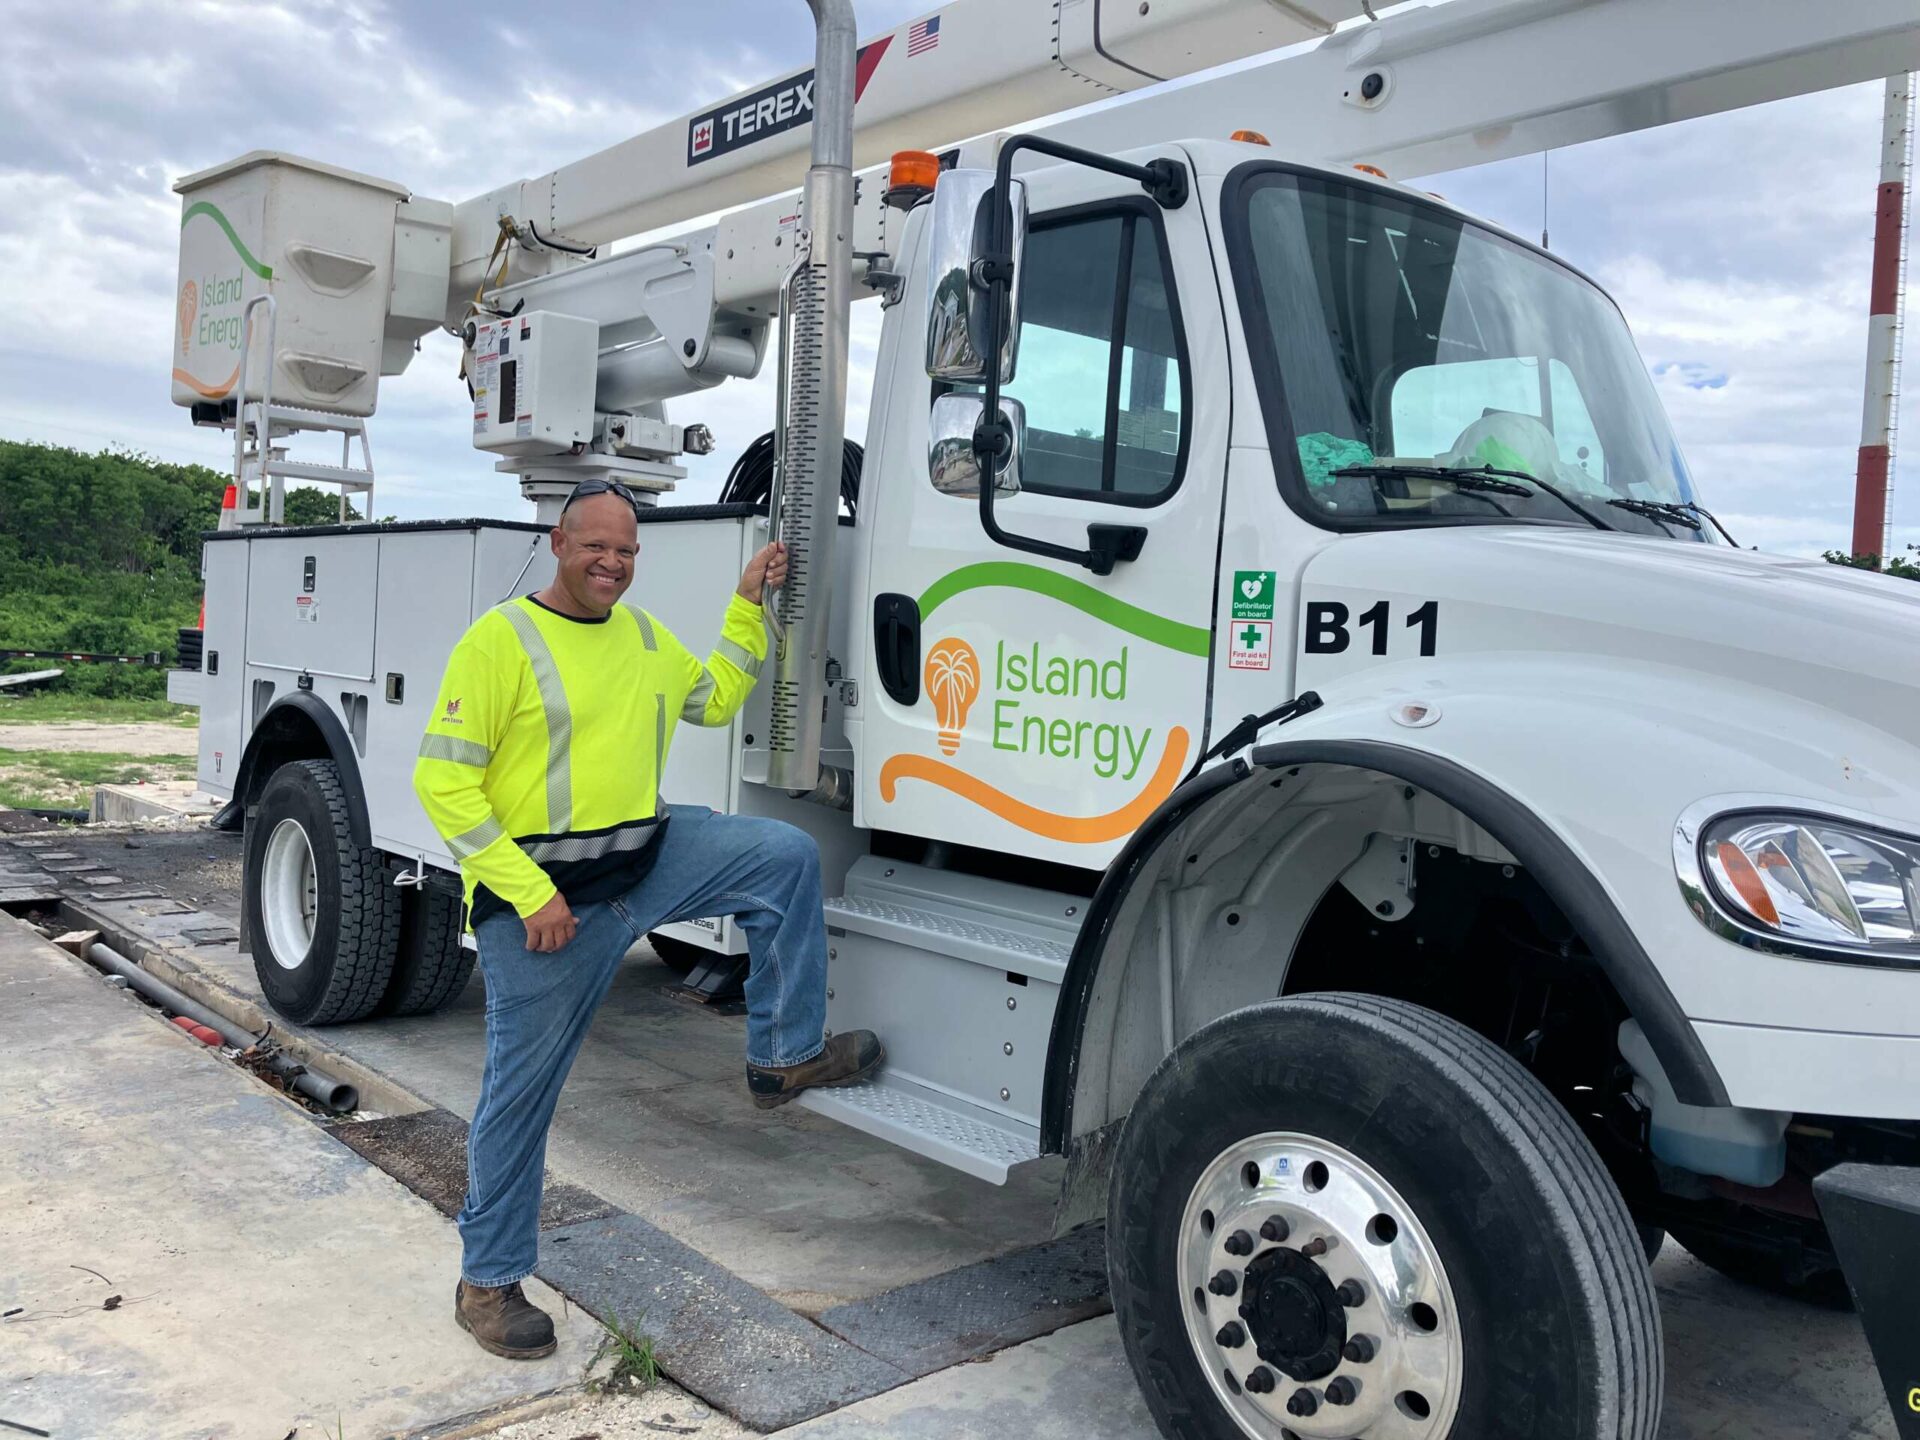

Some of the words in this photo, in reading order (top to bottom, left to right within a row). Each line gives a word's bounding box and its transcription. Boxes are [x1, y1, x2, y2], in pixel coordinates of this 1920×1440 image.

[721, 79, 814, 142] TEREX
[201, 267, 243, 308] Island
[1234, 602, 1272, 610] Defibrillator
[1304, 600, 1439, 657] B11
[995, 639, 1129, 701] Island
[992, 699, 1153, 781] Energy
